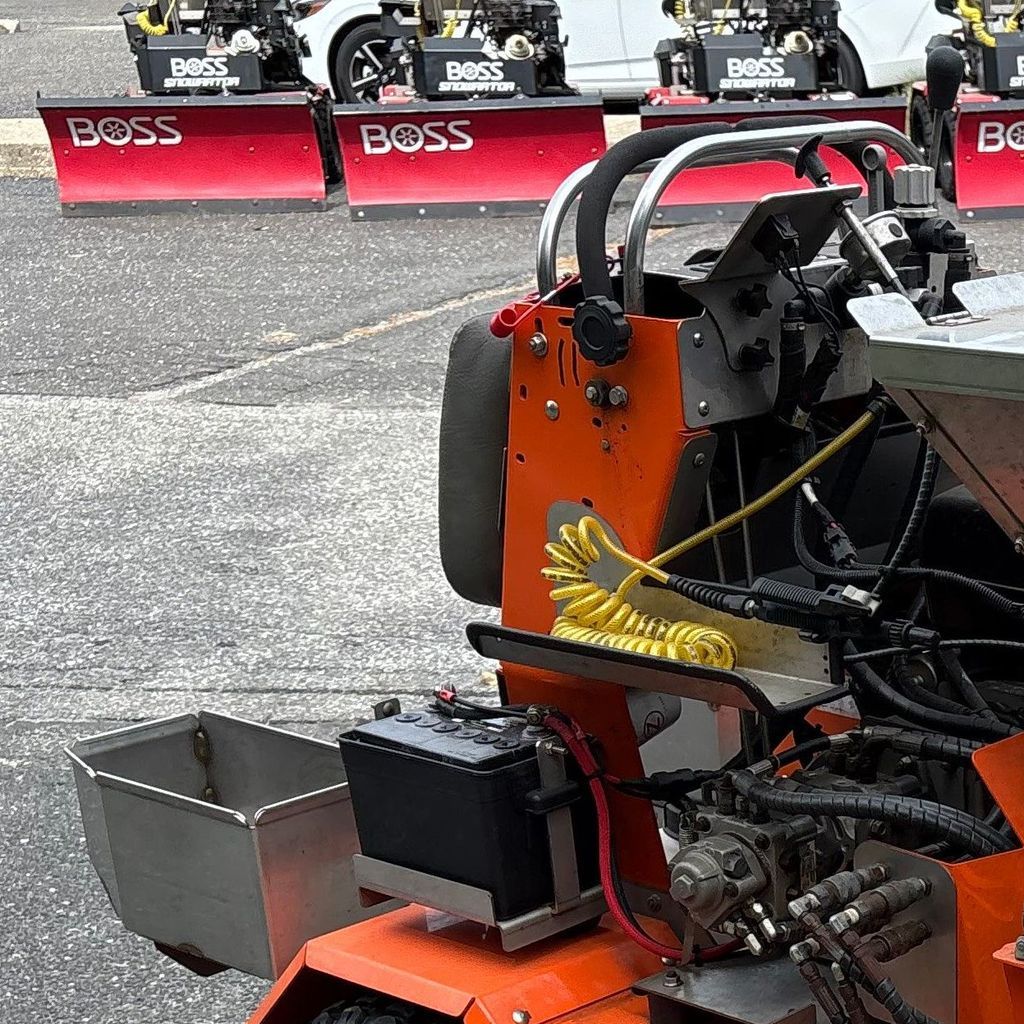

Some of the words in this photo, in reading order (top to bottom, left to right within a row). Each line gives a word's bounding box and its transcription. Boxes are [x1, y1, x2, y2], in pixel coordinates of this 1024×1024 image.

[170, 57, 229, 77] BOSS
[445, 61, 504, 81] BOSS
[726, 57, 785, 78] BOSS
[66, 115, 183, 149] BOSS
[359, 119, 475, 155] BOSS
